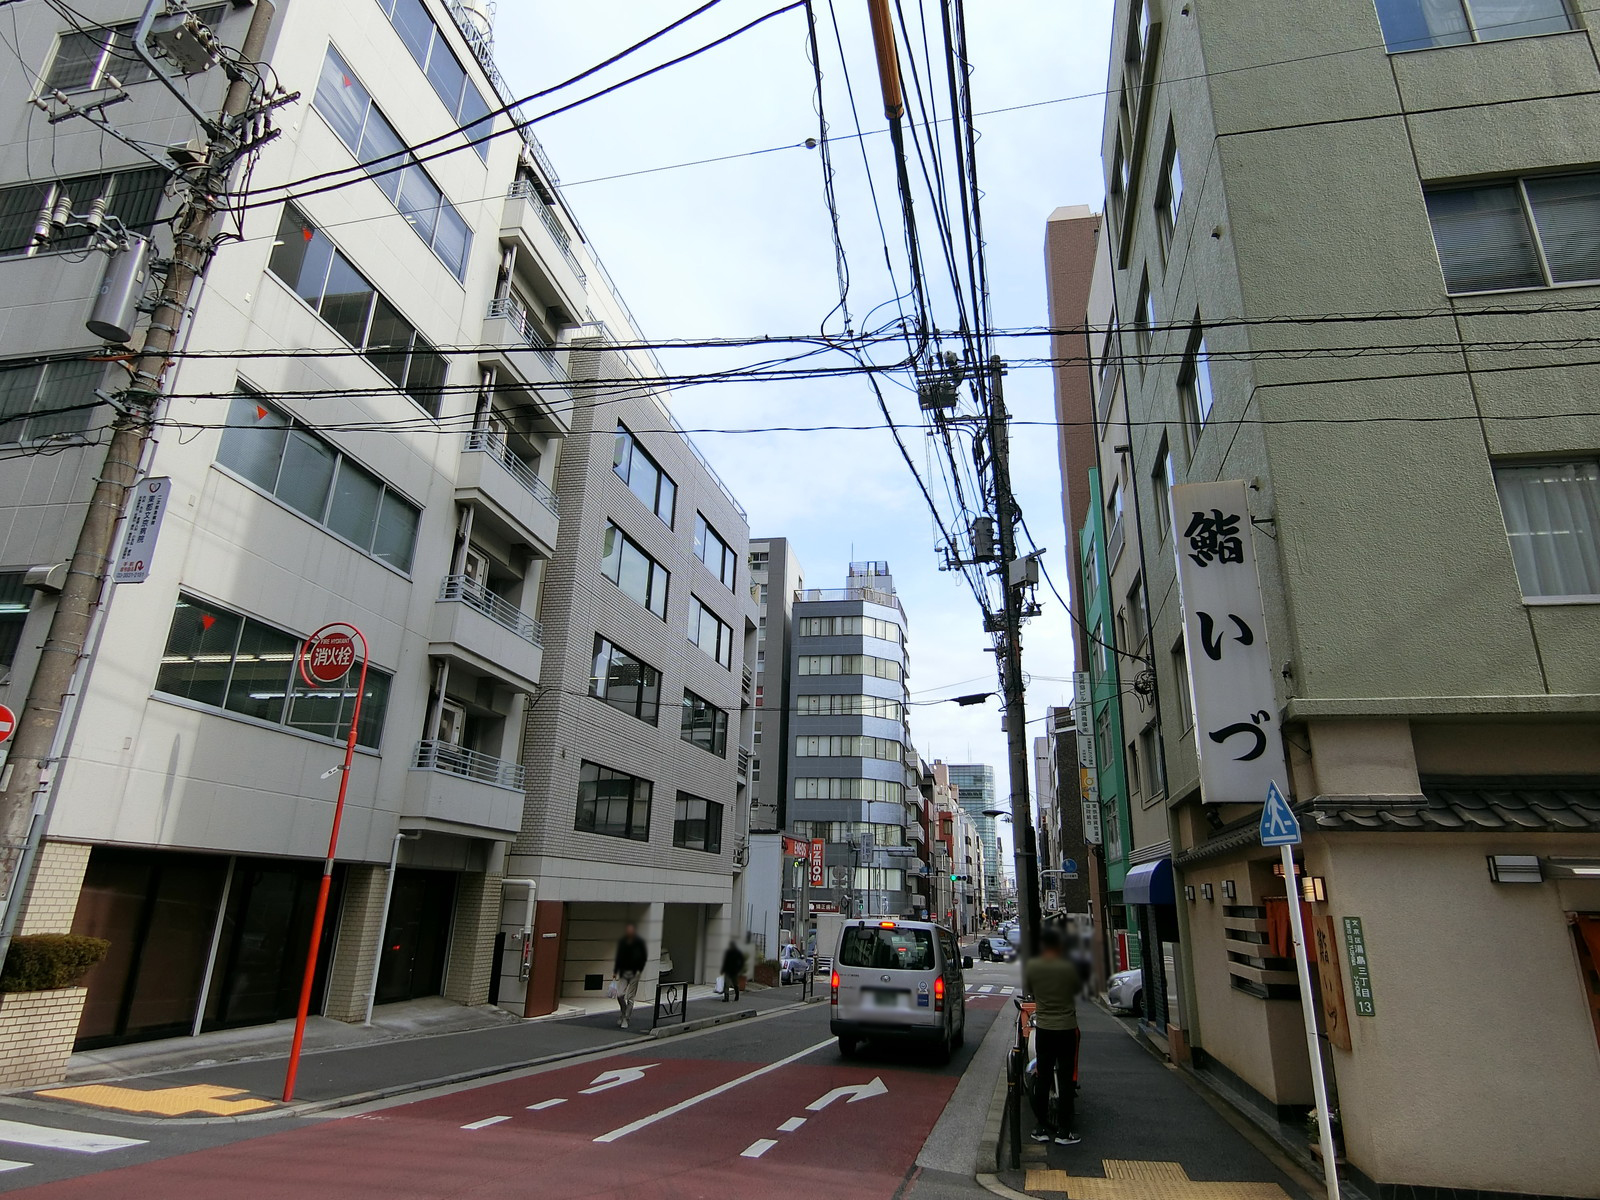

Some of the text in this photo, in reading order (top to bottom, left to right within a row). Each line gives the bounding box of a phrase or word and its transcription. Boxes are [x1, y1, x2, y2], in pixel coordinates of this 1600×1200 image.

[1184, 508, 1271, 761] 鮨いづ
[313, 646, 352, 666] 消火栓
[794, 840, 807, 856] ENEOS
[812, 843, 822, 882] ENEOS
[1358, 1001, 1372, 1013] 13
